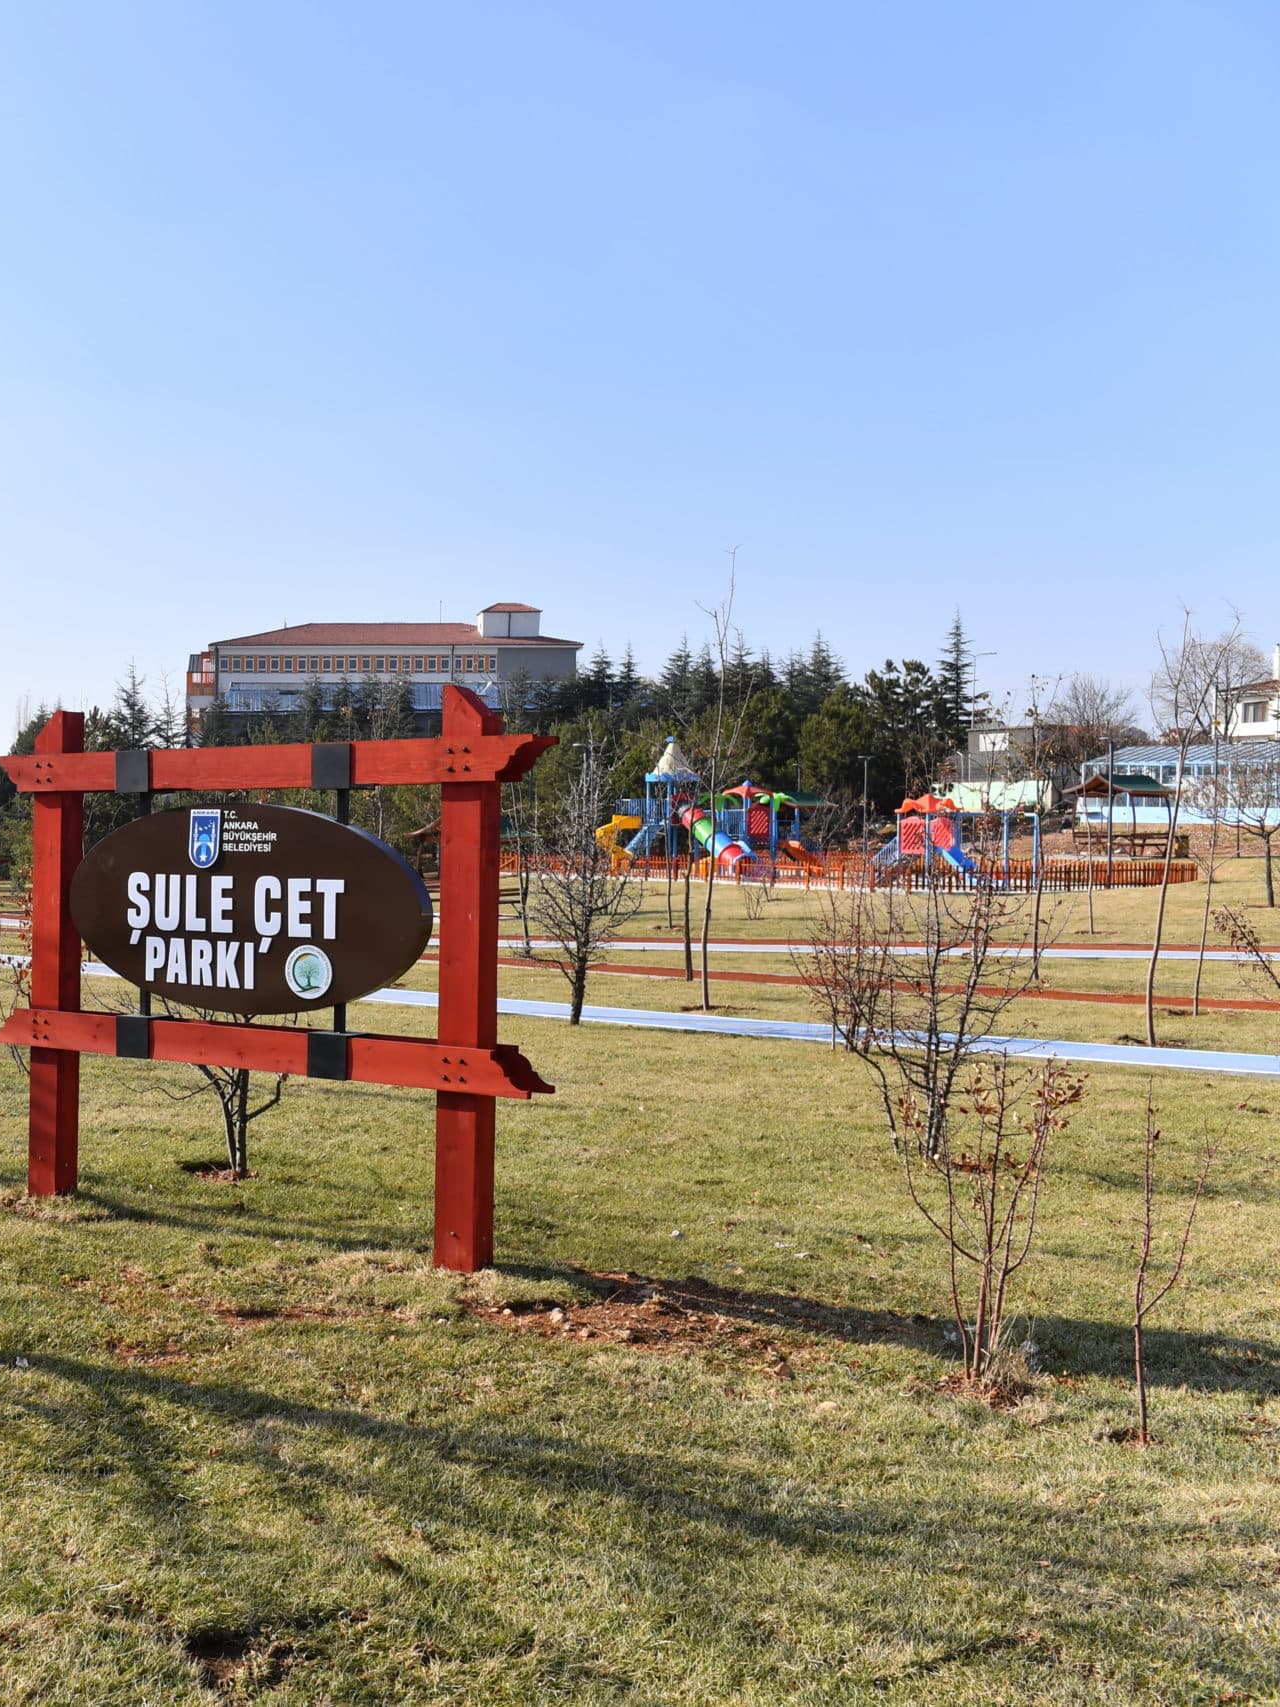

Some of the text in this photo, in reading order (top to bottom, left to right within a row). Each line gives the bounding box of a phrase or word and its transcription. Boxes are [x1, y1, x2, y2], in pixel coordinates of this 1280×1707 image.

[223, 810, 238, 819] T.C.
[223, 821, 259, 830] ANKARA
[223, 831, 277, 843] BÜYÜKŞEHİR
[223, 842, 272, 853] BELEDİYESİ
[127, 871, 345, 954] ŞULE ÇET
[145, 936, 256, 990] PARKI
